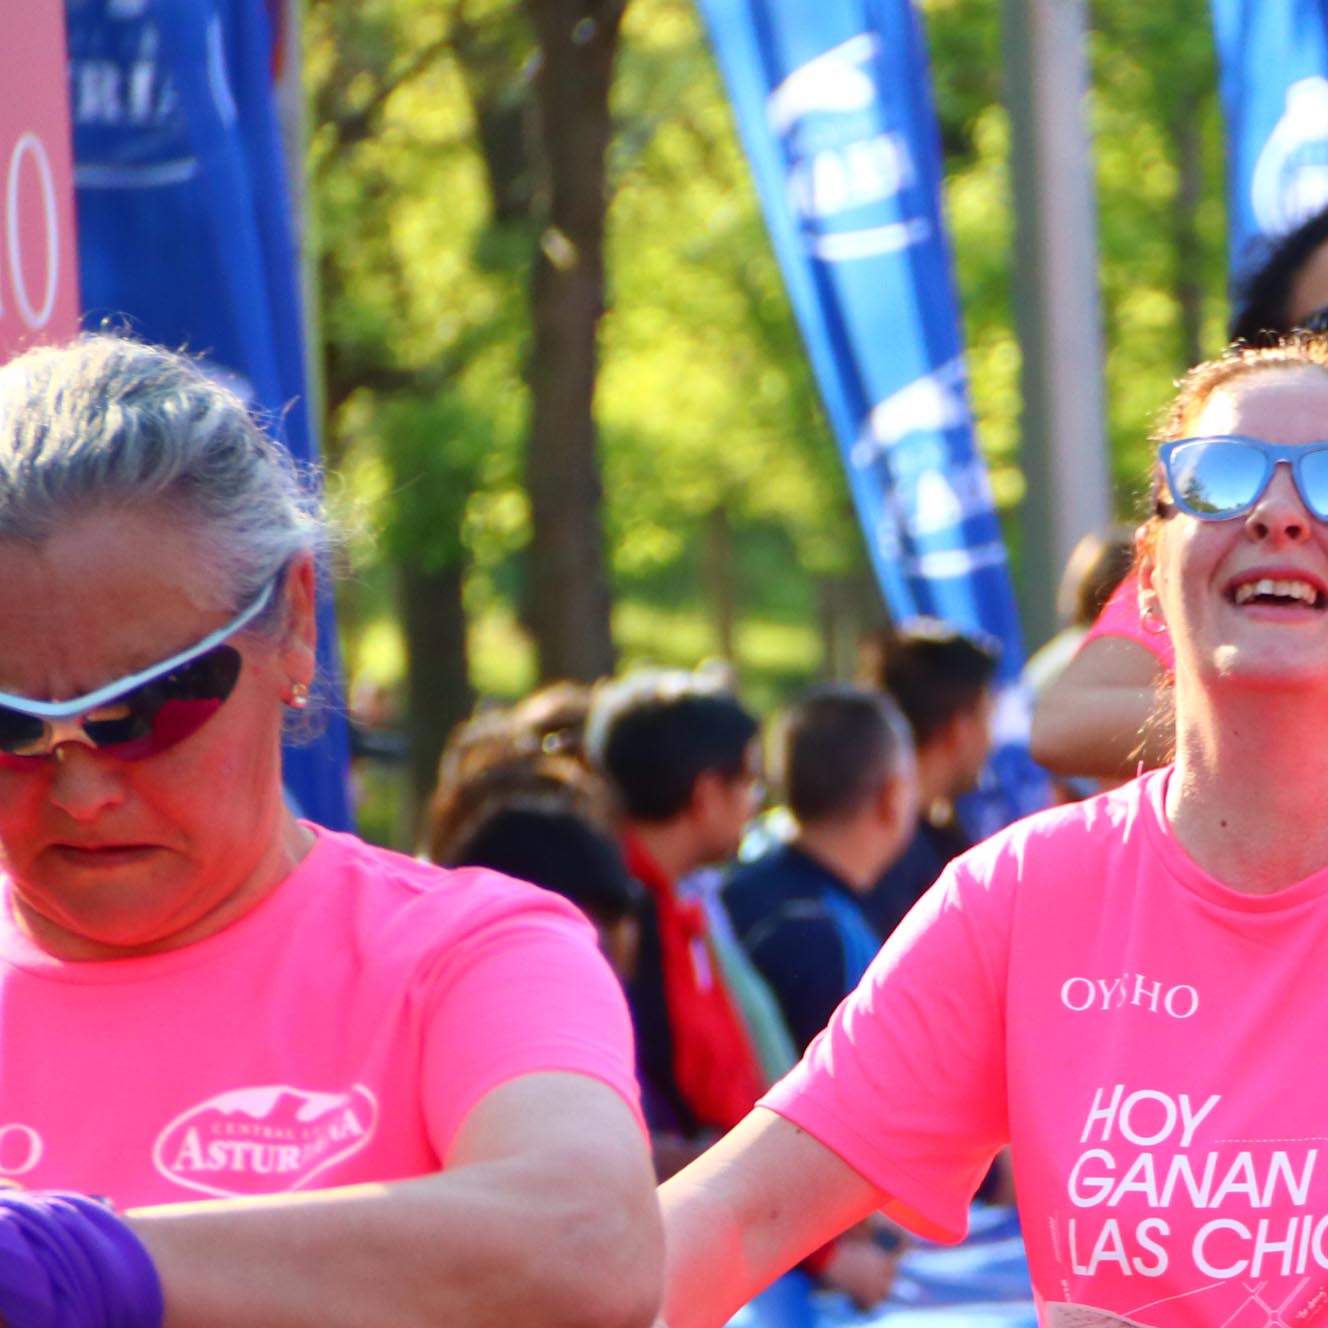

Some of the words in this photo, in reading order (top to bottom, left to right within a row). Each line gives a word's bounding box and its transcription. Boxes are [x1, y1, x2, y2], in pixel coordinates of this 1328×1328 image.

[1060, 972, 1200, 1019] OYSHO
[1078, 1082, 1221, 1148] HOY
[1066, 1148, 1319, 1210] GANAN
[1067, 1217, 1171, 1278] LAS
